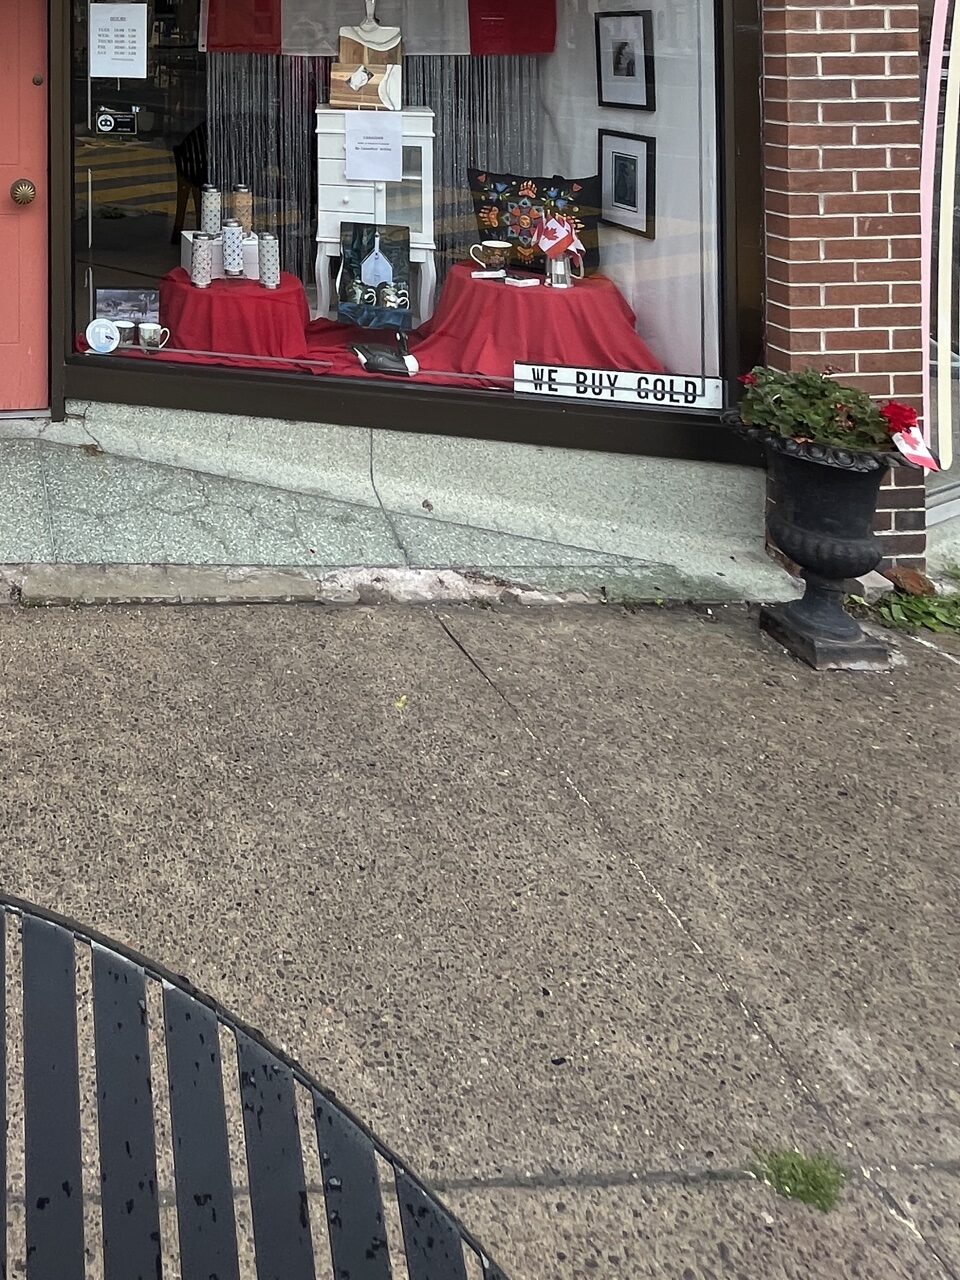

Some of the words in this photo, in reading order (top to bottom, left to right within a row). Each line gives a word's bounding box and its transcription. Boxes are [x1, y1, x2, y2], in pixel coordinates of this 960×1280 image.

[531, 367, 559, 393] WE
[575, 370, 619, 398] BUY
[636, 375, 698, 405] GOLD
